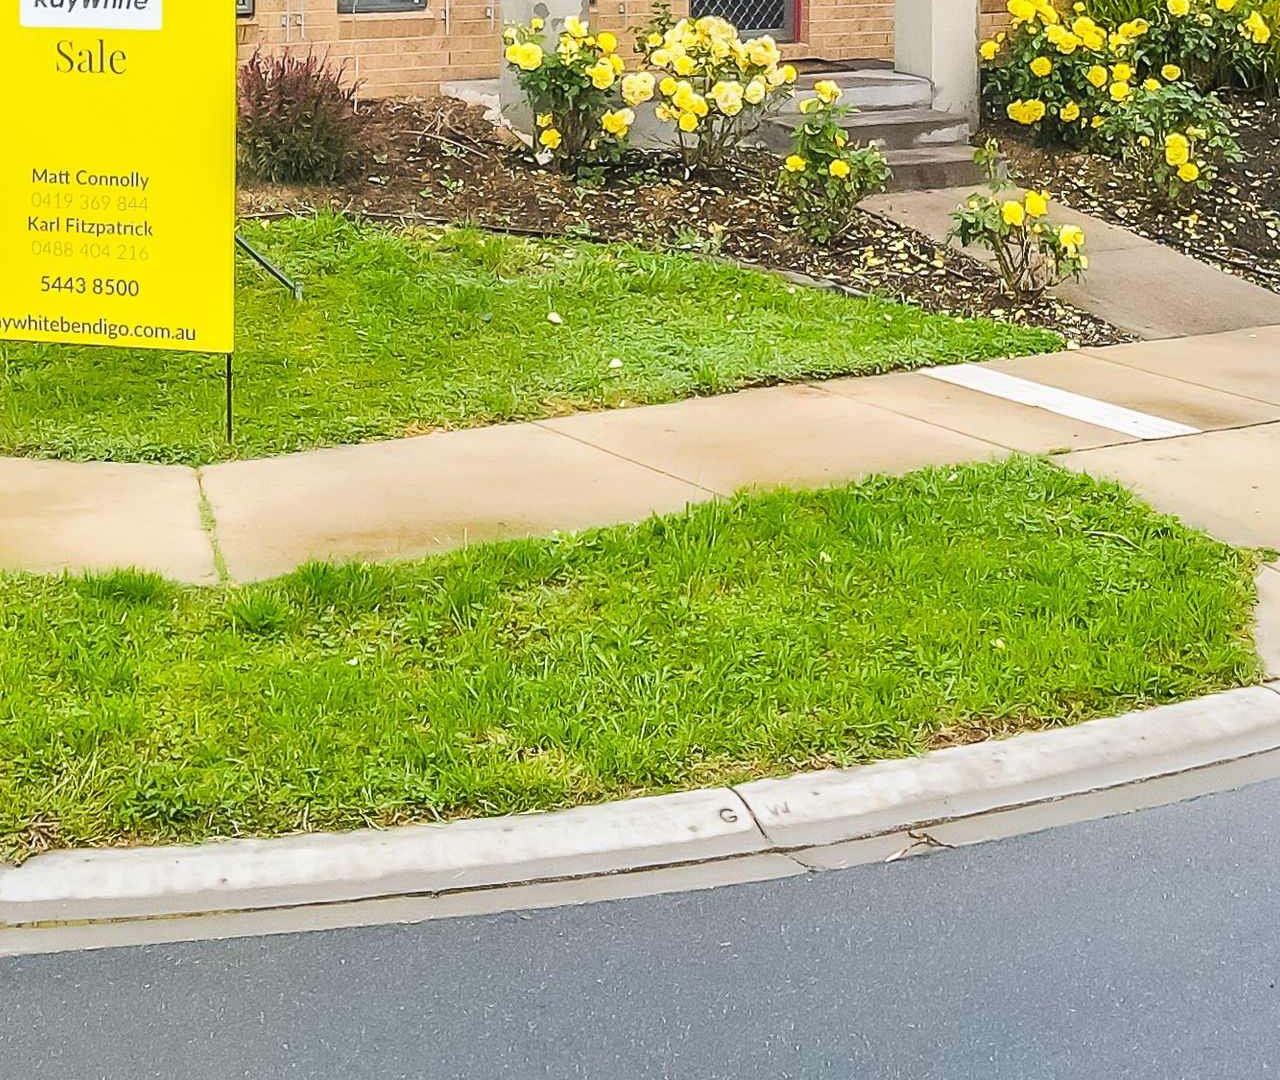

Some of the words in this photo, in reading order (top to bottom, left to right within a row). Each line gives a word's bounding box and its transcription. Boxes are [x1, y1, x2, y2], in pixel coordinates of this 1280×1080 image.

[55, 38, 127, 75] Sale
[32, 168, 70, 185] Matt
[76, 170, 149, 191] Connolly
[31, 192, 73, 210] 0419
[79, 193, 111, 211] 369
[117, 195, 148, 211] 844
[27, 216, 60, 232] Karl
[65, 218, 153, 237] Fitzpatrick
[31, 240, 73, 257] 0488
[79, 242, 111, 259] 404
[117, 244, 149, 261] 216
[40, 275, 86, 294] 5443
[92, 278, 140, 297] 8500
